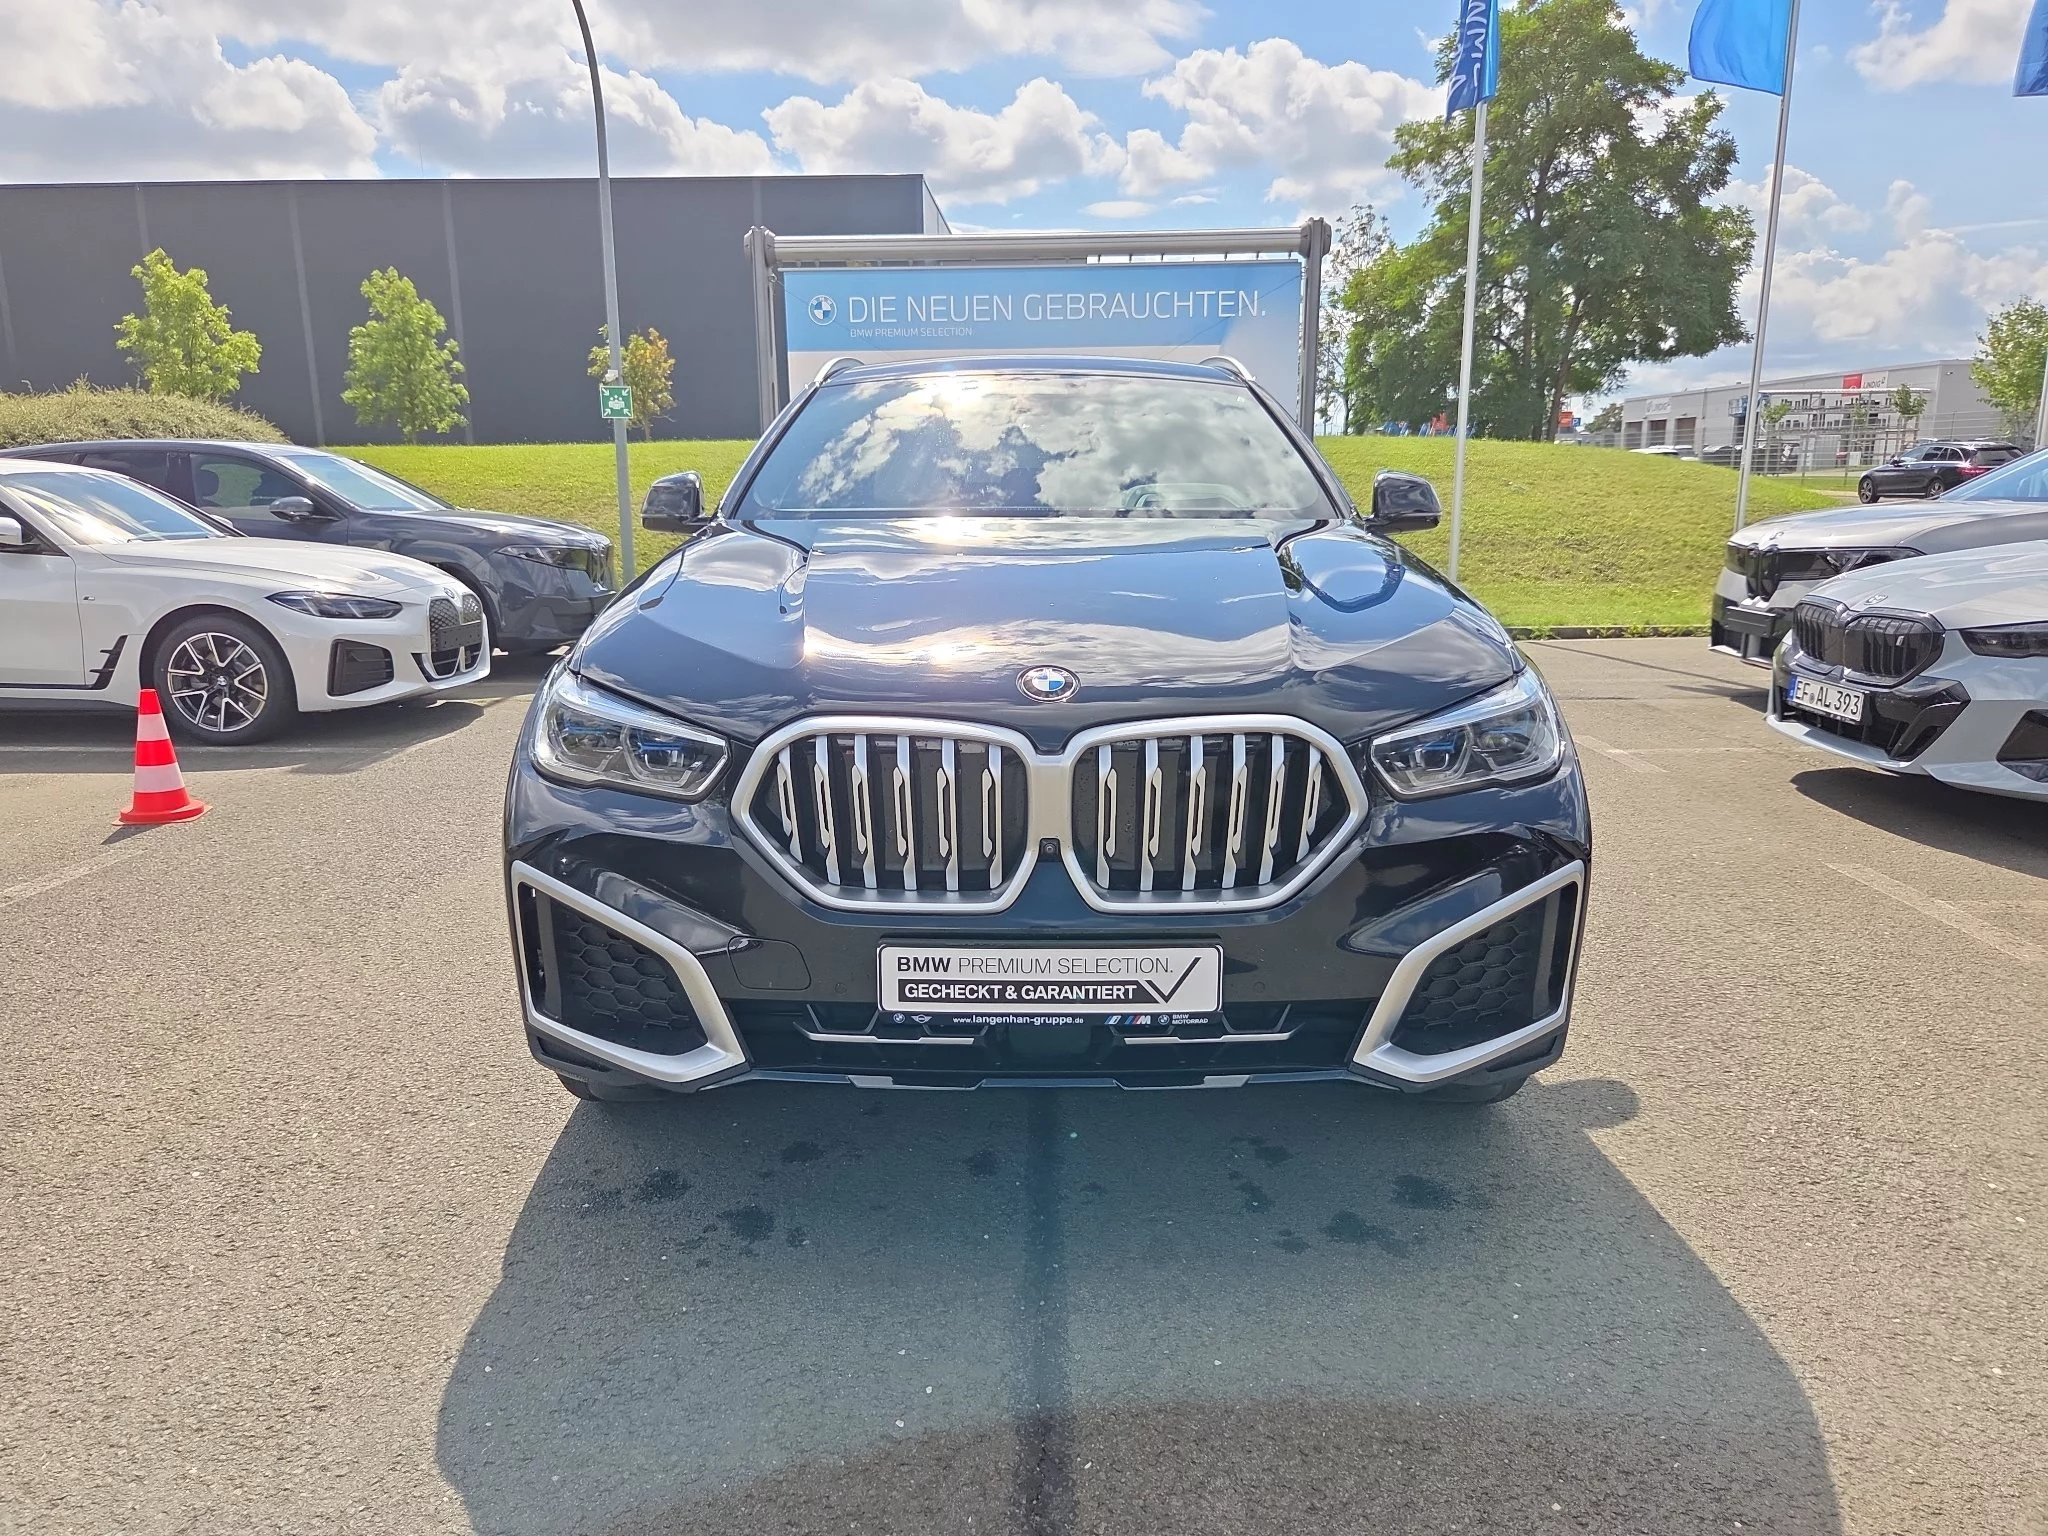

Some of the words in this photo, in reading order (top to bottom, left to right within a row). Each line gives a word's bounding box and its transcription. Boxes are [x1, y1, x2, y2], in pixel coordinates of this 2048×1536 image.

[849, 296, 897, 323] DIE
[907, 294, 1012, 322] NEUEN
[1023, 290, 1266, 321] GEBRAUCHTEN.
[850, 328, 873, 338] BMW
[875, 328, 919, 337] PREMIUM
[1816, 686, 1832, 708] AL
[1834, 690, 1861, 715] 393
[897, 956, 951, 973] BMW
[958, 956, 1051, 974] PREMIUM
[1057, 956, 1174, 974] SELECTION.
[904, 983, 1003, 1000] GECHECKT
[1005, 984, 1018, 1000] &
[1021, 984, 1138, 1001] GARANTIERT
[952, 1014, 1084, 1026] www.langenhan-gruppe.de
